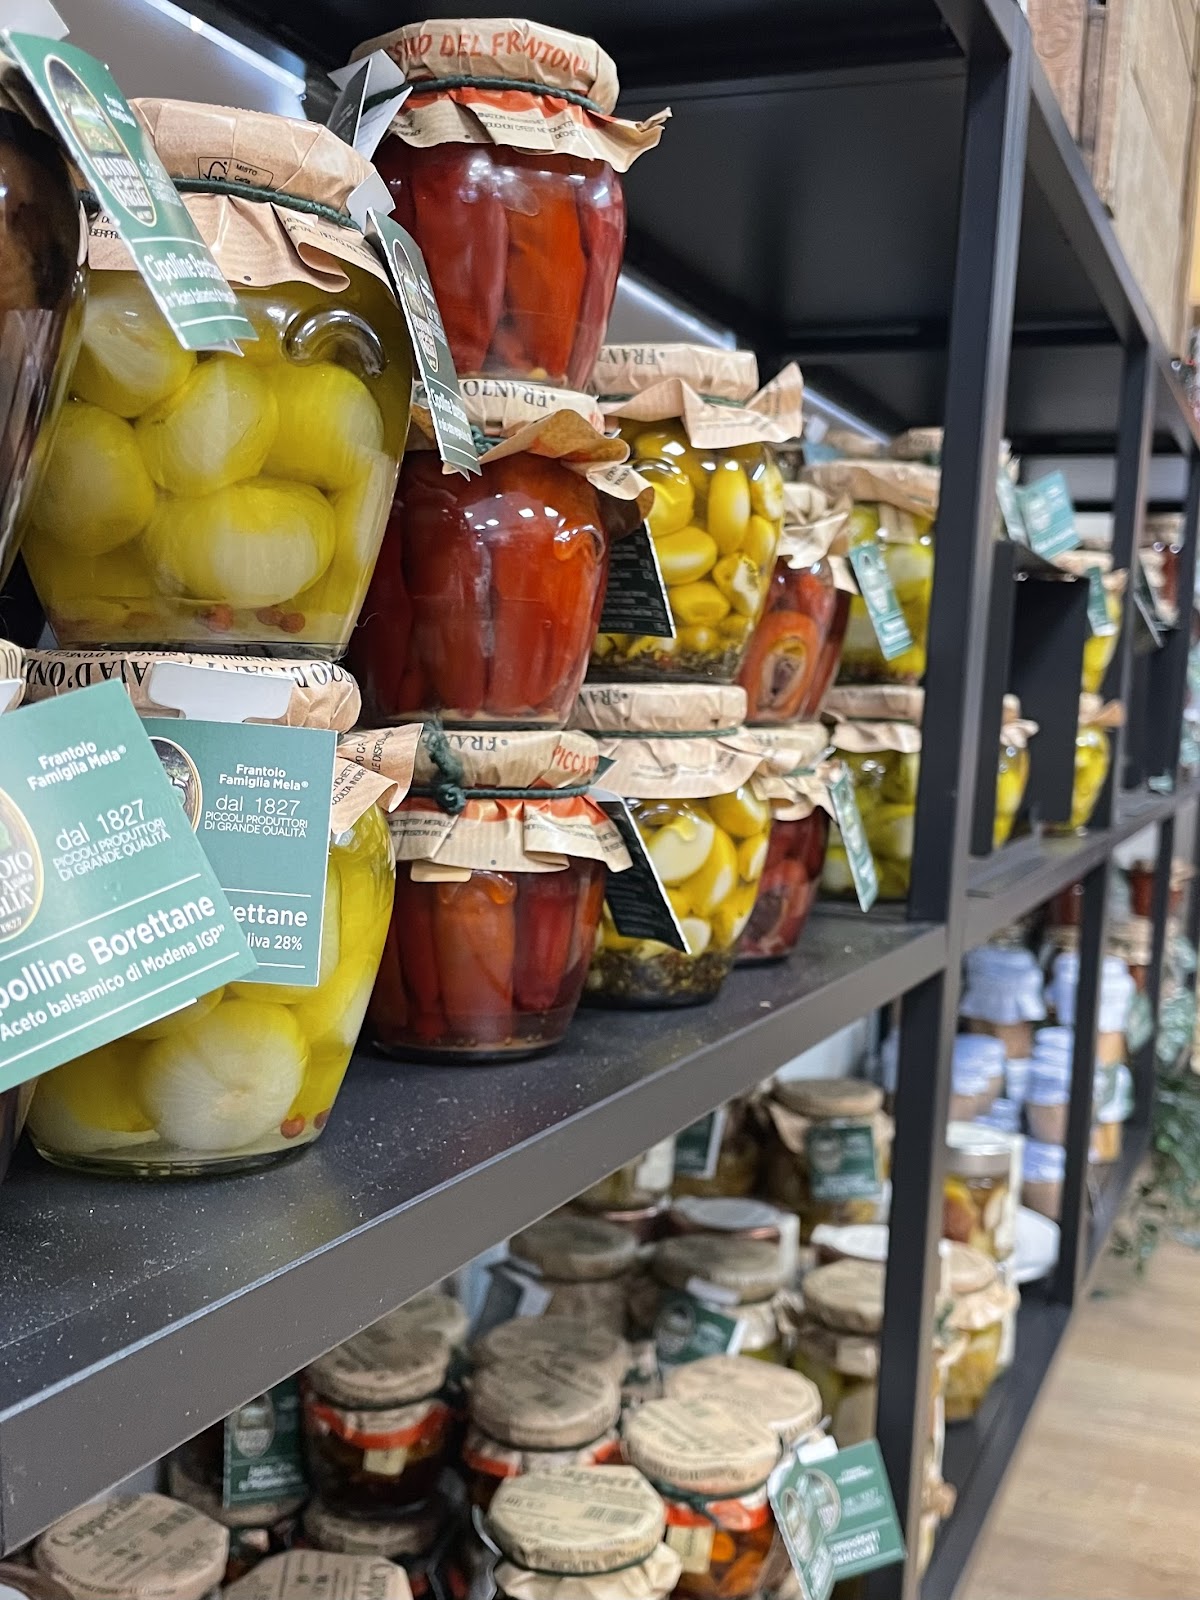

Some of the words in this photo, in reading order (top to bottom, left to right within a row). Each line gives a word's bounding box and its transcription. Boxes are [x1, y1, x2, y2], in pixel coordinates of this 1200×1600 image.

[440, 34, 482, 56] DEL
[236, 163, 258, 176] MISTO
[38, 741, 97, 770] Frantoio
[27, 760, 89, 791] Famiglia
[219, 773, 270, 789] Famiglia
[236, 764, 286, 778] Frantoio
[216, 794, 243, 812] dal
[255, 797, 300, 816] 1827
[56, 821, 90, 850] dal
[97, 799, 145, 834] 1827
[205, 811, 244, 823] PICCOLI
[246, 814, 308, 829] PRODUTTORI
[205, 820, 215, 830] DI
[217, 822, 260, 835] GRANDE
[53, 842, 100, 869] PICCOLI
[99, 817, 166, 850] PRODUTTORI
[58, 868, 74, 882] DI
[75, 848, 124, 876] GRANDE
[230, 903, 308, 927] ettane
[88, 896, 216, 965] Borettane
[275, 935, 303, 951] 28%
[1, 1008, 48, 1042] Aceto
[47, 973, 125, 1018] balsamico
[126, 962, 142, 982] di
[140, 940, 198, 975] Modena
